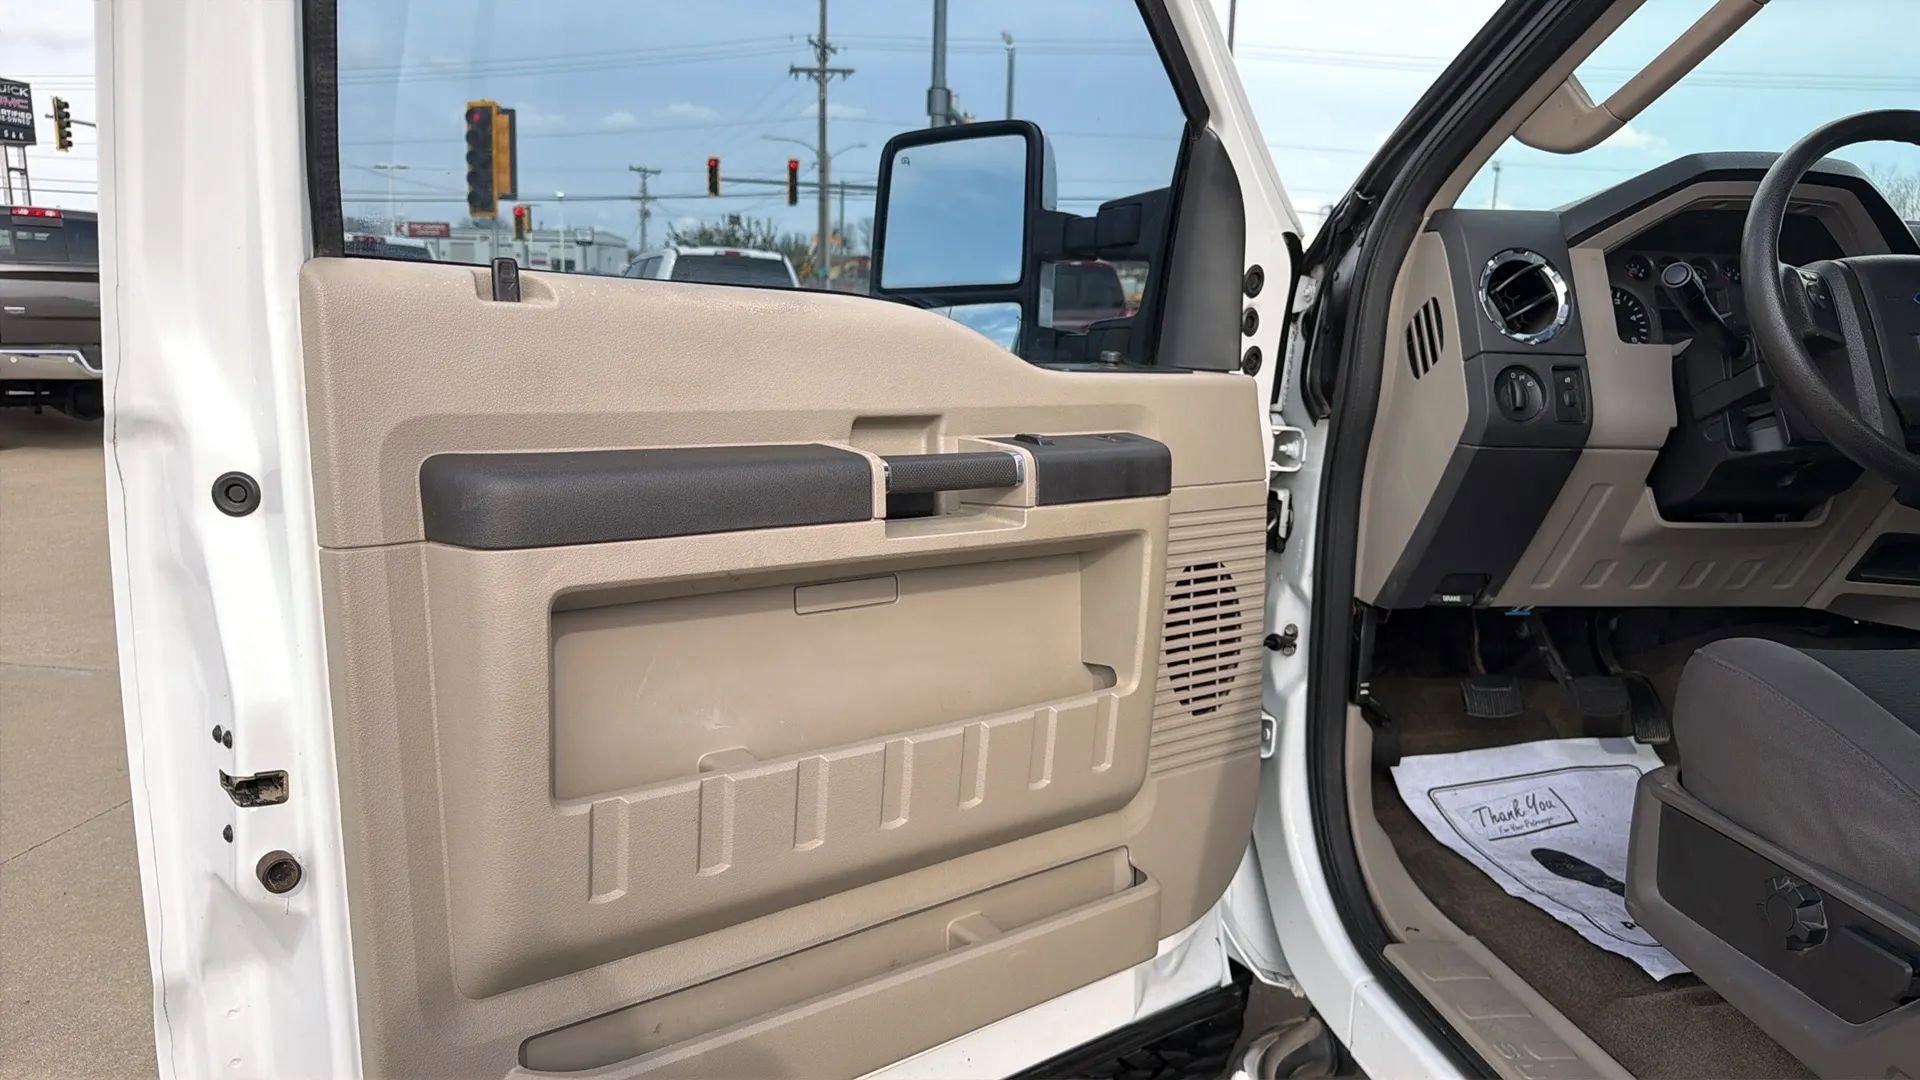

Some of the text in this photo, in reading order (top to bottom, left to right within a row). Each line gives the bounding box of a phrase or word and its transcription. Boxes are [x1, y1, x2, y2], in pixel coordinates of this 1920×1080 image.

[0, 84, 29, 97] UICK
[0, 109, 32, 121] RTIFIED
[1472, 792, 1557, 828] Thank You
